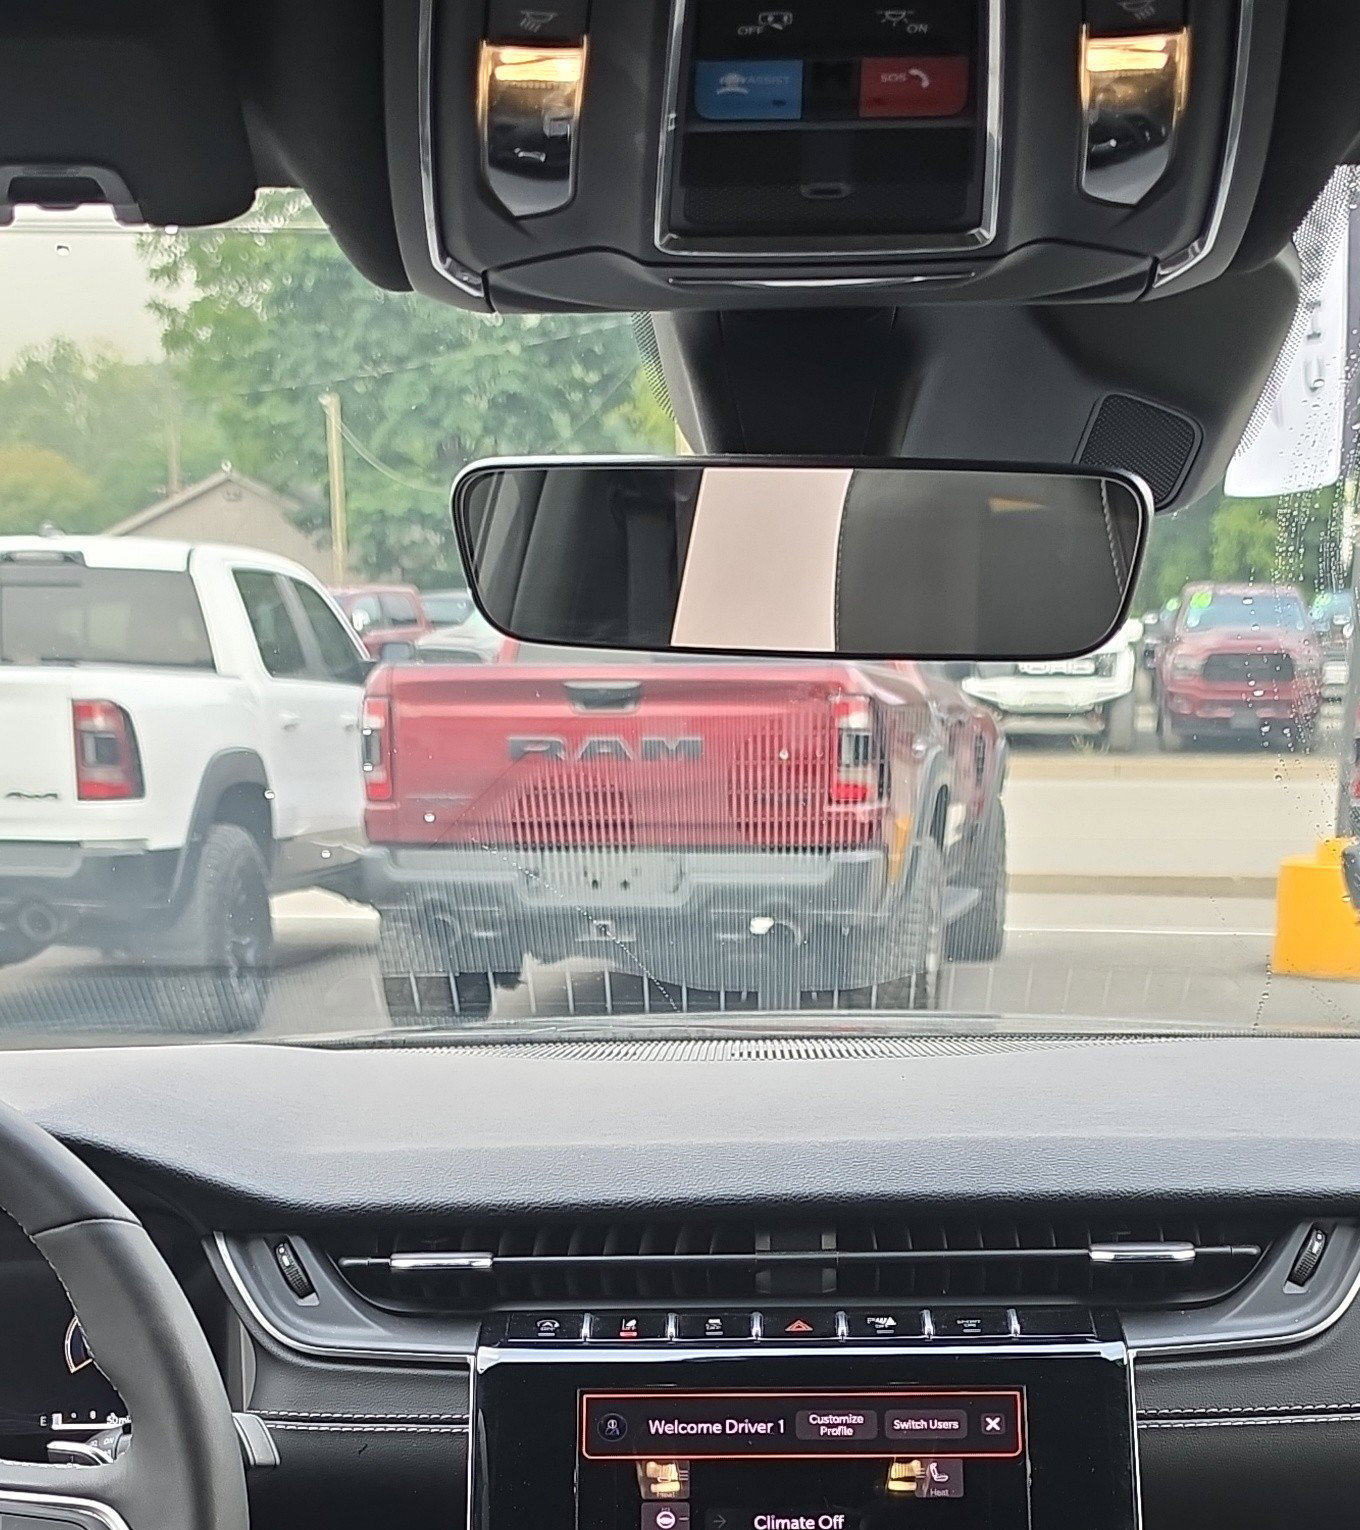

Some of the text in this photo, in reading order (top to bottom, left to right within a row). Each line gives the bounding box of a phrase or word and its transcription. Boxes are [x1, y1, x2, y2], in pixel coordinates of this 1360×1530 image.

[737, 26, 764, 35] OFF
[907, 24, 928, 34] ON
[881, 73, 906, 82] SOS
[508, 735, 703, 762] RAM
[40, 1416, 47, 1426] E
[808, 1413, 864, 1425] Customize
[893, 1418, 960, 1430] Switch Users
[648, 1418, 785, 1434] Welcome Driver 1
[820, 1425, 853, 1437] Profile
[929, 1488, 949, 1497] Heat
[753, 1514, 845, 1530] Climate Off
